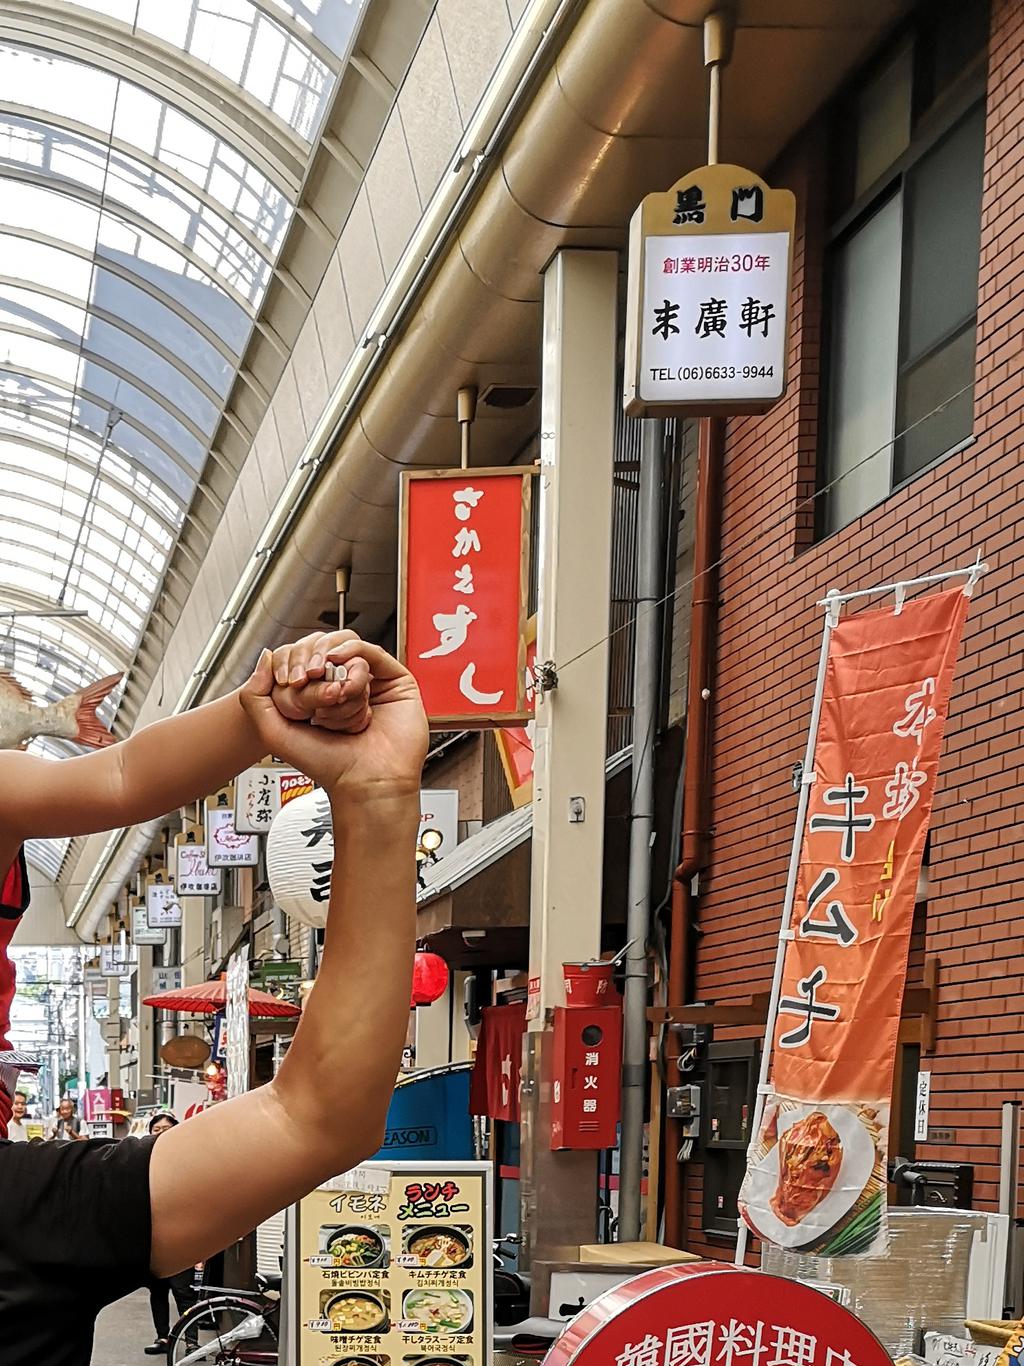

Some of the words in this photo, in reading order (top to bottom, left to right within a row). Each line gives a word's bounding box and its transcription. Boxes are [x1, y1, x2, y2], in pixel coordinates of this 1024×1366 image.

[672, 184, 764, 225] 黒門
[662, 254, 771, 274] 創業明治30年
[778, 773, 876, 1048] キムチ
[583, 1052, 599, 1112] 消火器
[404, 1181, 460, 1203] ランチ
[328, 1193, 387, 1213] イモネ
[397, 1201, 470, 1221] メニュー
[408, 1270, 467, 1279] キムチチゲ定食
